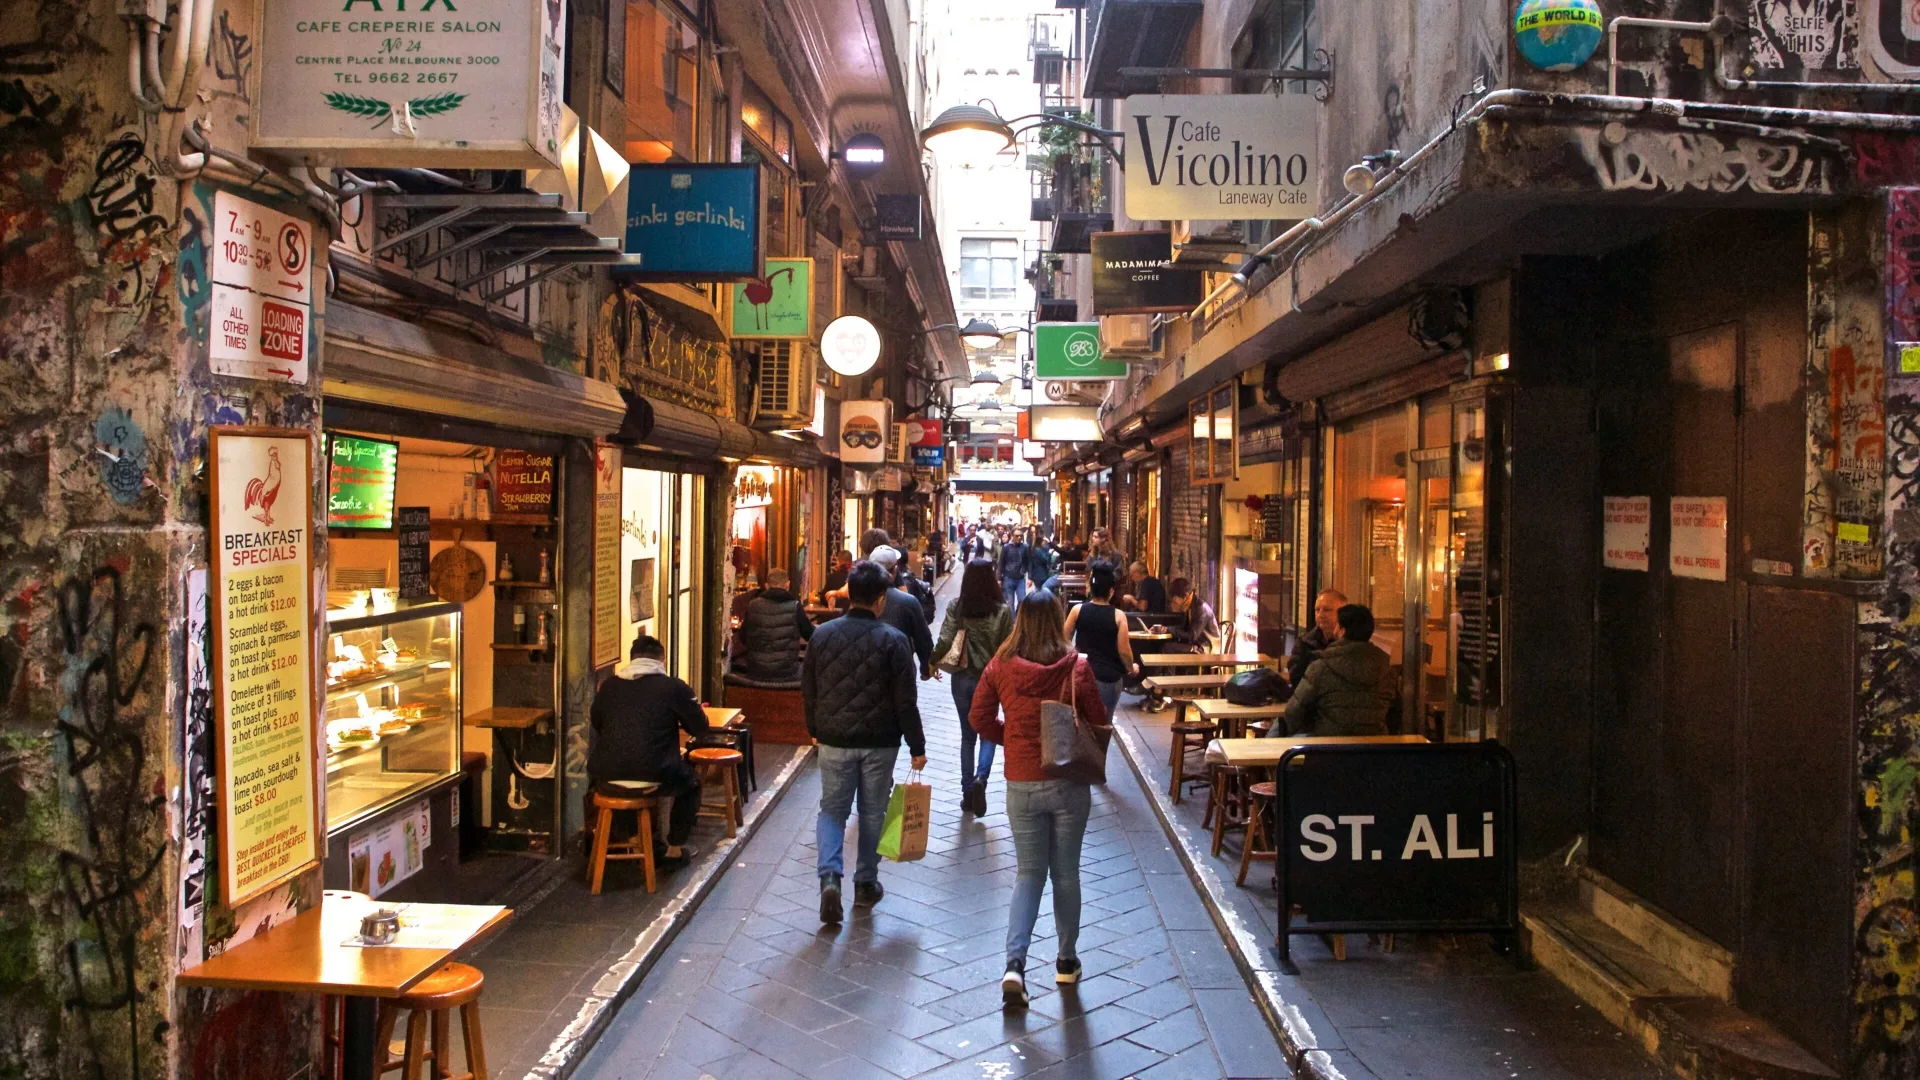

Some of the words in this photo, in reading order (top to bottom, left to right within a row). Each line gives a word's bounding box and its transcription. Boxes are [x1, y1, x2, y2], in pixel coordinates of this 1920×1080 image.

[296, 22, 342, 32] CAFE
[348, 22, 435, 32] CREPERIE
[442, 22, 500, 32] SALON
[1520, 14, 1538, 28] THE
[1544, 10, 1586, 22] WORLD
[1588, 12, 1596, 23] IS
[1784, 16, 1825, 30] SELFIE
[406, 40, 421, 52] 24
[1786, 33, 1825, 54] THIS
[467, 56, 500, 65] 3000
[368, 72, 410, 84] 9662
[417, 72, 458, 84] 2667
[1181, 120, 1220, 142] Cafe
[1132, 115, 1307, 186] Vicolino
[1219, 190, 1274, 208] Laneway
[1278, 189, 1307, 204] Cafe
[674, 202, 744, 231] gerlinki
[230, 306, 244, 320] ALL
[262, 308, 303, 334] LOADING
[222, 320, 249, 336] OTHER
[224, 335, 248, 351] TIMES
[264, 331, 300, 355] ZONE
[1052, 384, 1061, 394] M
[526, 454, 552, 467] SUGAR
[500, 470, 551, 484] NUTELLA
[329, 496, 362, 512] Smoothie
[501, 492, 551, 504] STRAWBERRY
[224, 529, 303, 550] BREAKFAST
[232, 545, 297, 566] SPECIALS
[1684, 556, 1694, 566] BILL
[1696, 558, 1720, 569] POSTERS
[228, 580, 234, 591] 2
[236, 580, 252, 592] eggs
[255, 576, 260, 587] &
[262, 574, 284, 585] bacon
[228, 596, 238, 605] on
[240, 592, 258, 603] toast
[260, 588, 275, 602] plus
[229, 611, 234, 620] a
[236, 607, 248, 618] hot
[250, 604, 268, 616] drink
[270, 596, 296, 612] $12.00
[230, 622, 268, 640] Scrambled
[270, 620, 288, 633] eggs,
[230, 638, 258, 654] spinach
[260, 636, 266, 646] &
[268, 630, 300, 646] parmesan
[230, 658, 240, 668] on
[242, 653, 258, 664] toast
[262, 648, 276, 660] plus
[230, 673, 235, 682] a
[238, 668, 250, 680] hot
[252, 662, 270, 676] drink
[272, 654, 298, 672] $12.00
[231, 684, 264, 702] Omelette
[266, 678, 280, 691] with
[232, 702, 255, 716] choice
[258, 696, 264, 708] of
[266, 694, 272, 704] 3
[274, 688, 296, 700] fillings
[232, 720, 241, 730] on
[244, 714, 260, 726] toast
[263, 707, 278, 720] plus
[232, 736, 236, 744] a
[240, 730, 250, 742] hot
[253, 722, 271, 737] drink
[273, 712, 299, 730] $12.00
[234, 768, 266, 787] Avocado,
[268, 763, 280, 774] sea
[282, 754, 294, 766] salt
[296, 752, 300, 762] &
[234, 788, 250, 802] lime
[252, 784, 261, 793] on
[264, 766, 298, 790] sourdough
[234, 799, 252, 816] toast
[254, 788, 277, 806] $8.00
[236, 849, 248, 862] Step
[250, 840, 264, 856] inside
[266, 836, 275, 847] and
[276, 829, 289, 842] enjoy
[290, 824, 298, 834] the
[1300, 814, 1382, 862] ST.
[252, 844, 277, 868] QUICKEST
[282, 831, 306, 852] CHEAPEST
[237, 869, 262, 888] breakfast
[263, 864, 268, 873] in
[269, 860, 278, 870] the
